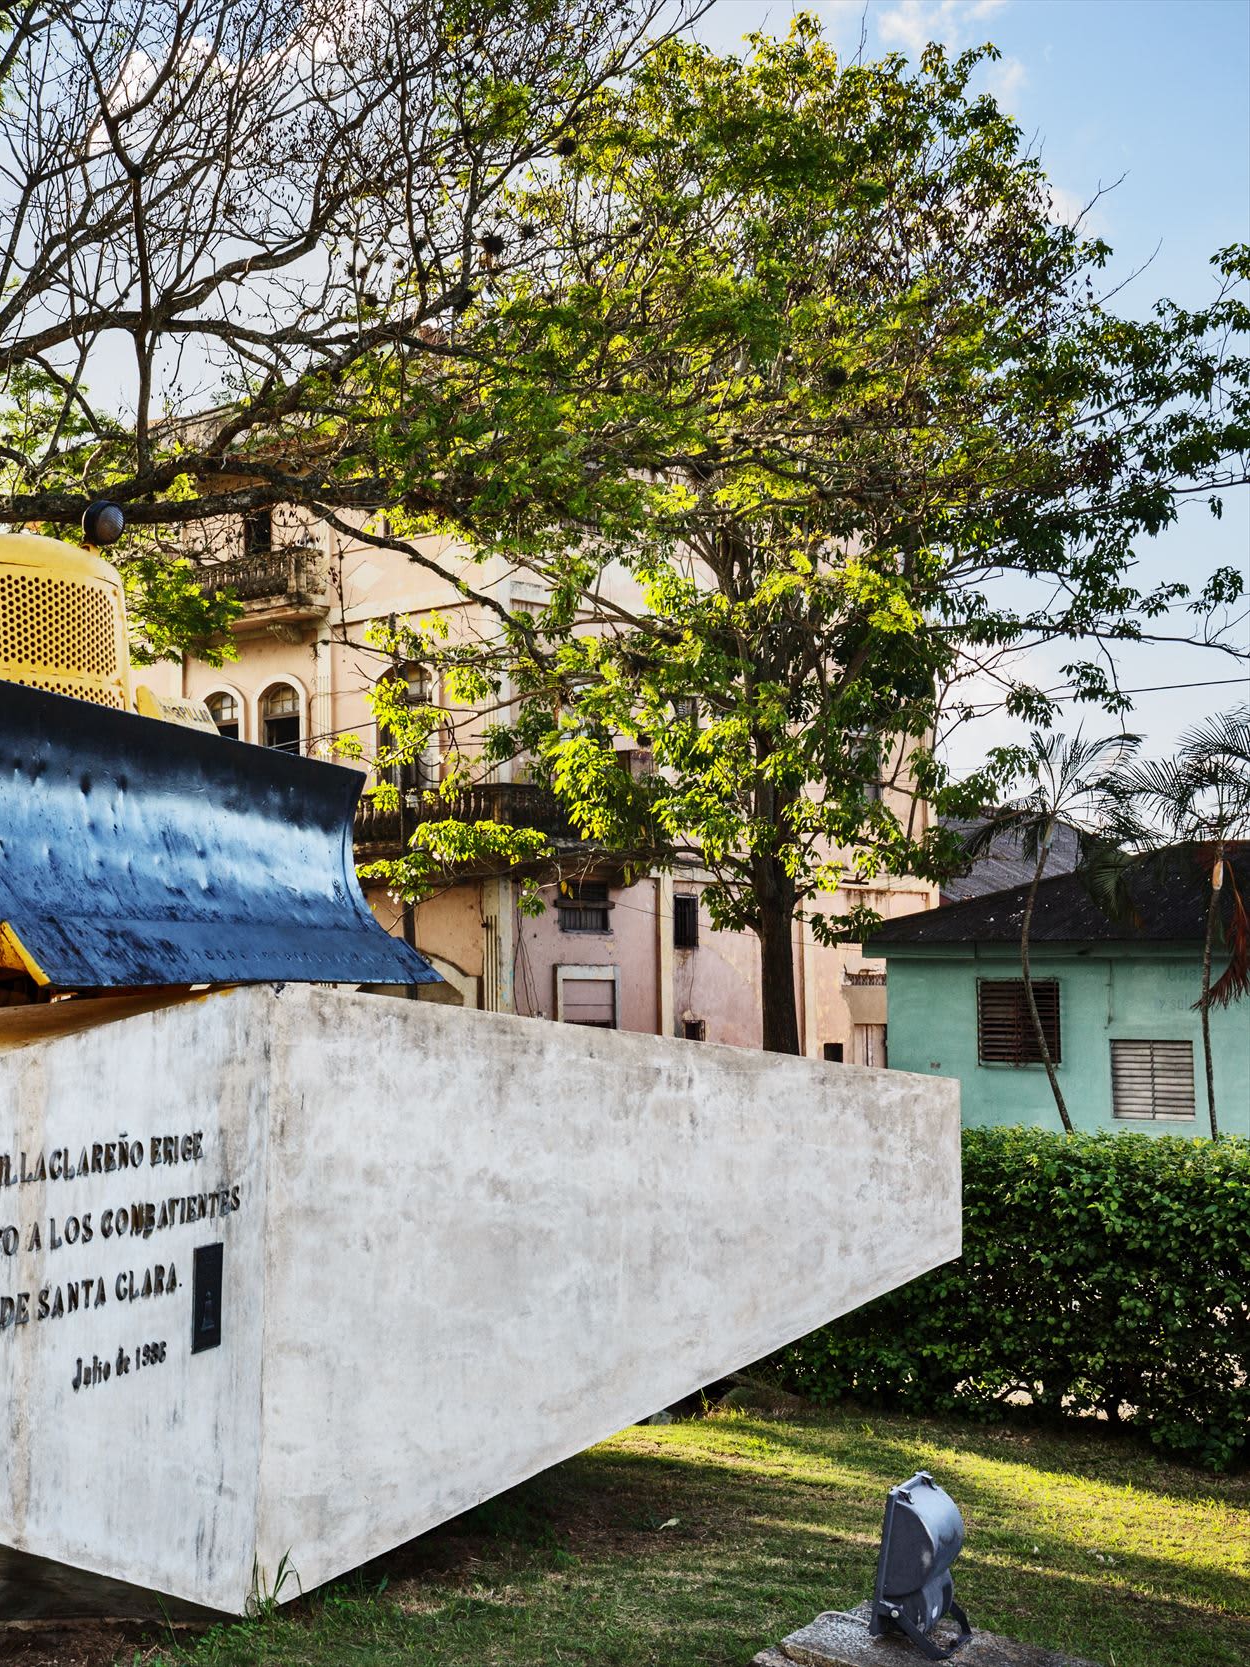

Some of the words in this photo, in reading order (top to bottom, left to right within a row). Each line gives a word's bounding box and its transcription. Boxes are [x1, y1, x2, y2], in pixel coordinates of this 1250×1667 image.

[150, 1130, 203, 1167] ERIGE
[27, 1221, 42, 1251] A
[50, 1213, 93, 1250] LOS
[101, 1185, 240, 1239] COMBATIENTES
[0, 1292, 30, 1330] DE
[37, 1276, 106, 1320] SANTA
[116, 1262, 183, 1302] CLARA.
[72, 1355, 111, 1393] Julio
[116, 1345, 130, 1376] de
